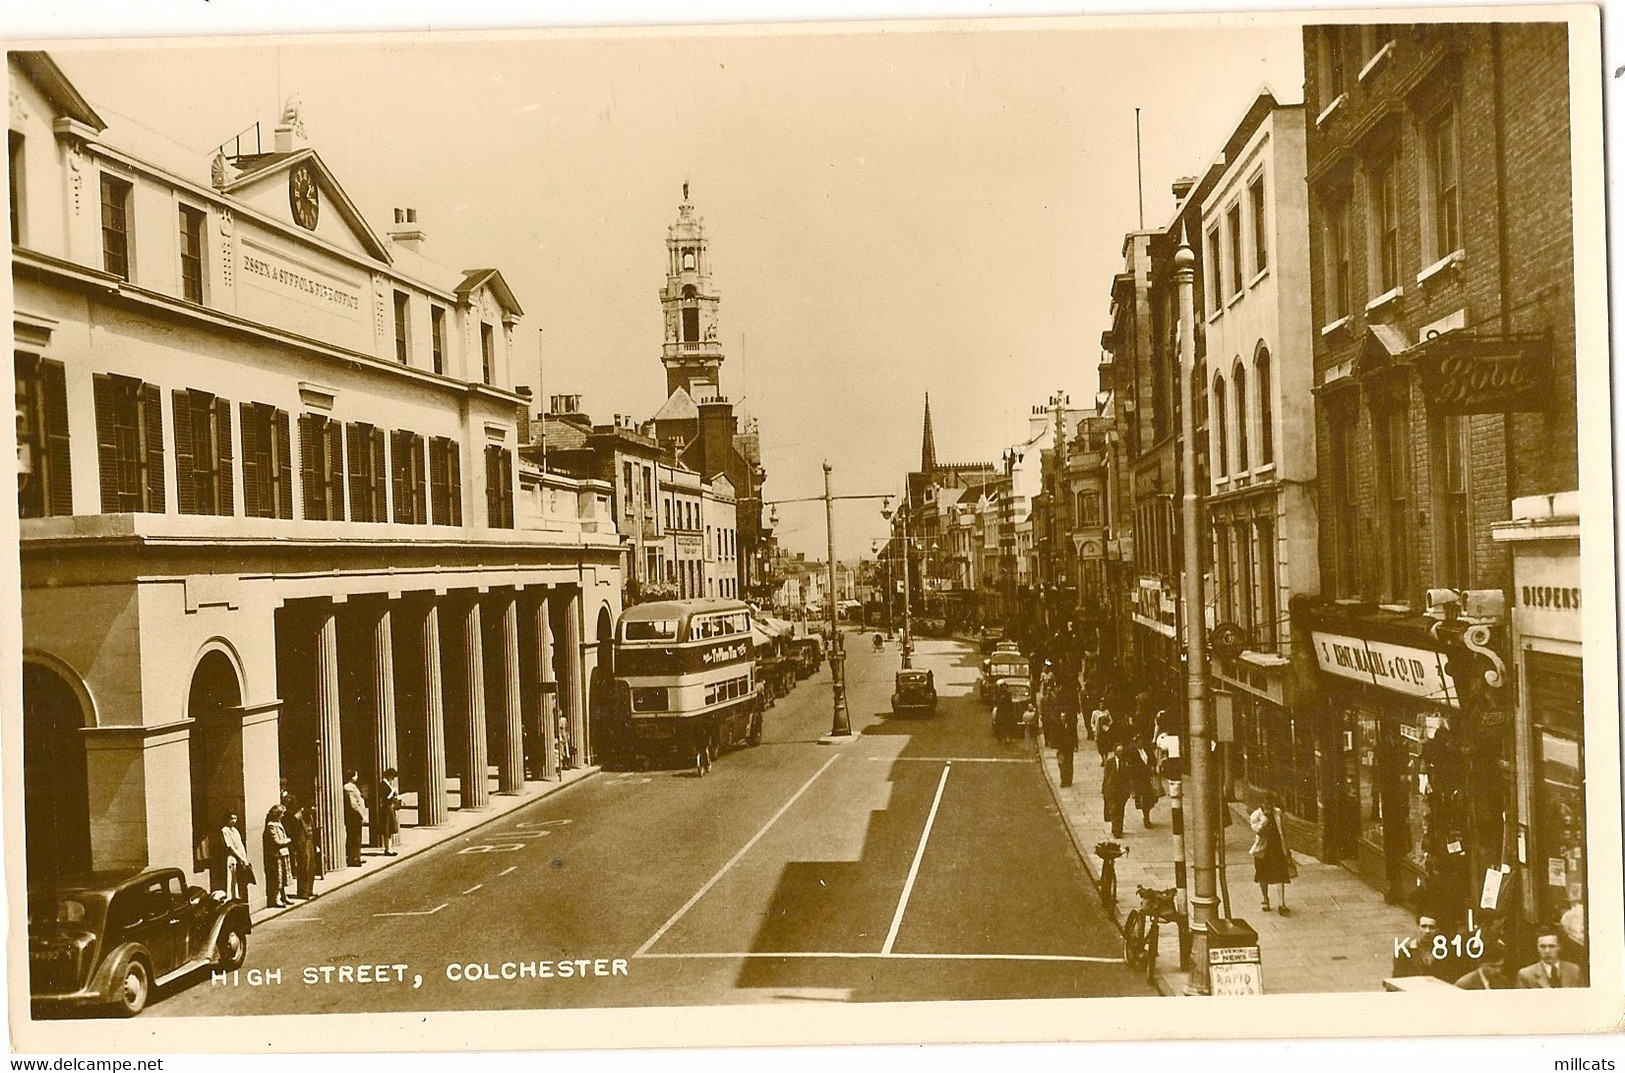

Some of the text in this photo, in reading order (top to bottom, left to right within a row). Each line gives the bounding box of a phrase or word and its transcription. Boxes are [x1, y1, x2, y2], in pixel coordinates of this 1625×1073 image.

[243, 255, 270, 278] ESSEX
[279, 269, 315, 294] SUFFOLK
[333, 290, 359, 310] OFFICE
[1522, 585, 1583, 610] DISPENS
[1321, 642, 1330, 663] 3
[456, 819, 574, 854] BUS
